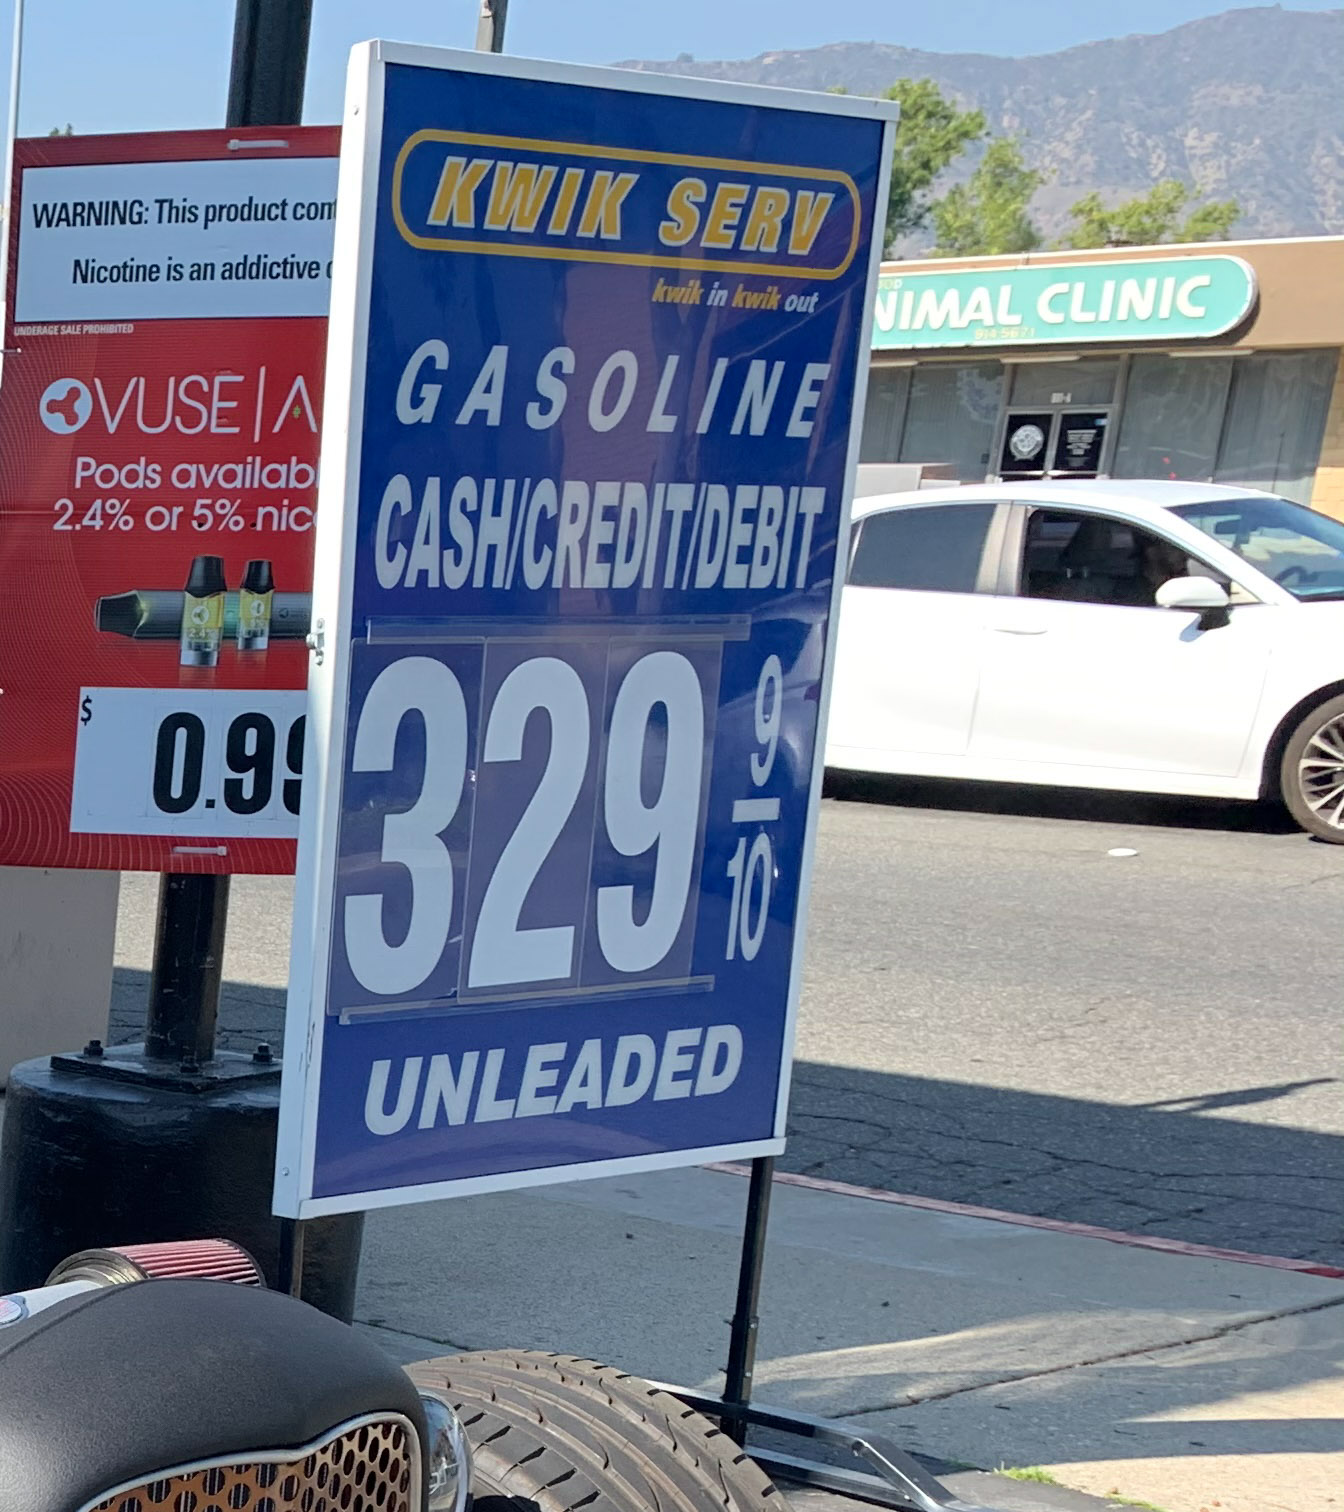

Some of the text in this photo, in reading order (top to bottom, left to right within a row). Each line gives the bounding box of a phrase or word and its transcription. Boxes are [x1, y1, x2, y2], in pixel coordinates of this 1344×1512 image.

[33, 199, 149, 229] WARNING:
[154, 198, 199, 224] This
[203, 196, 287, 230] product
[426, 156, 835, 256] KWIK SERV
[72, 258, 161, 284] Nicotine
[166, 256, 184, 281] is
[189, 261, 215, 280] an
[221, 254, 321, 281] addictive
[652, 278, 818, 313] kwik in kwik out
[1036, 274, 1211, 324] CLINIC
[14, 323, 134, 336] UNDERAGE SALE PROHIBITED
[94, 375, 245, 435] VUSE
[395, 339, 831, 438] GASOLINE
[74, 456, 162, 489] Pods
[53, 498, 134, 531] 2.4%
[145, 505, 184, 531] or
[192, 498, 245, 532] 5%
[375, 474, 826, 590] CASH/CREDIT/DEBIT
[80, 695, 93, 726] $
[344, 650, 784, 995] 329 9 10
[364, 1023, 743, 1136] UNLEADED
